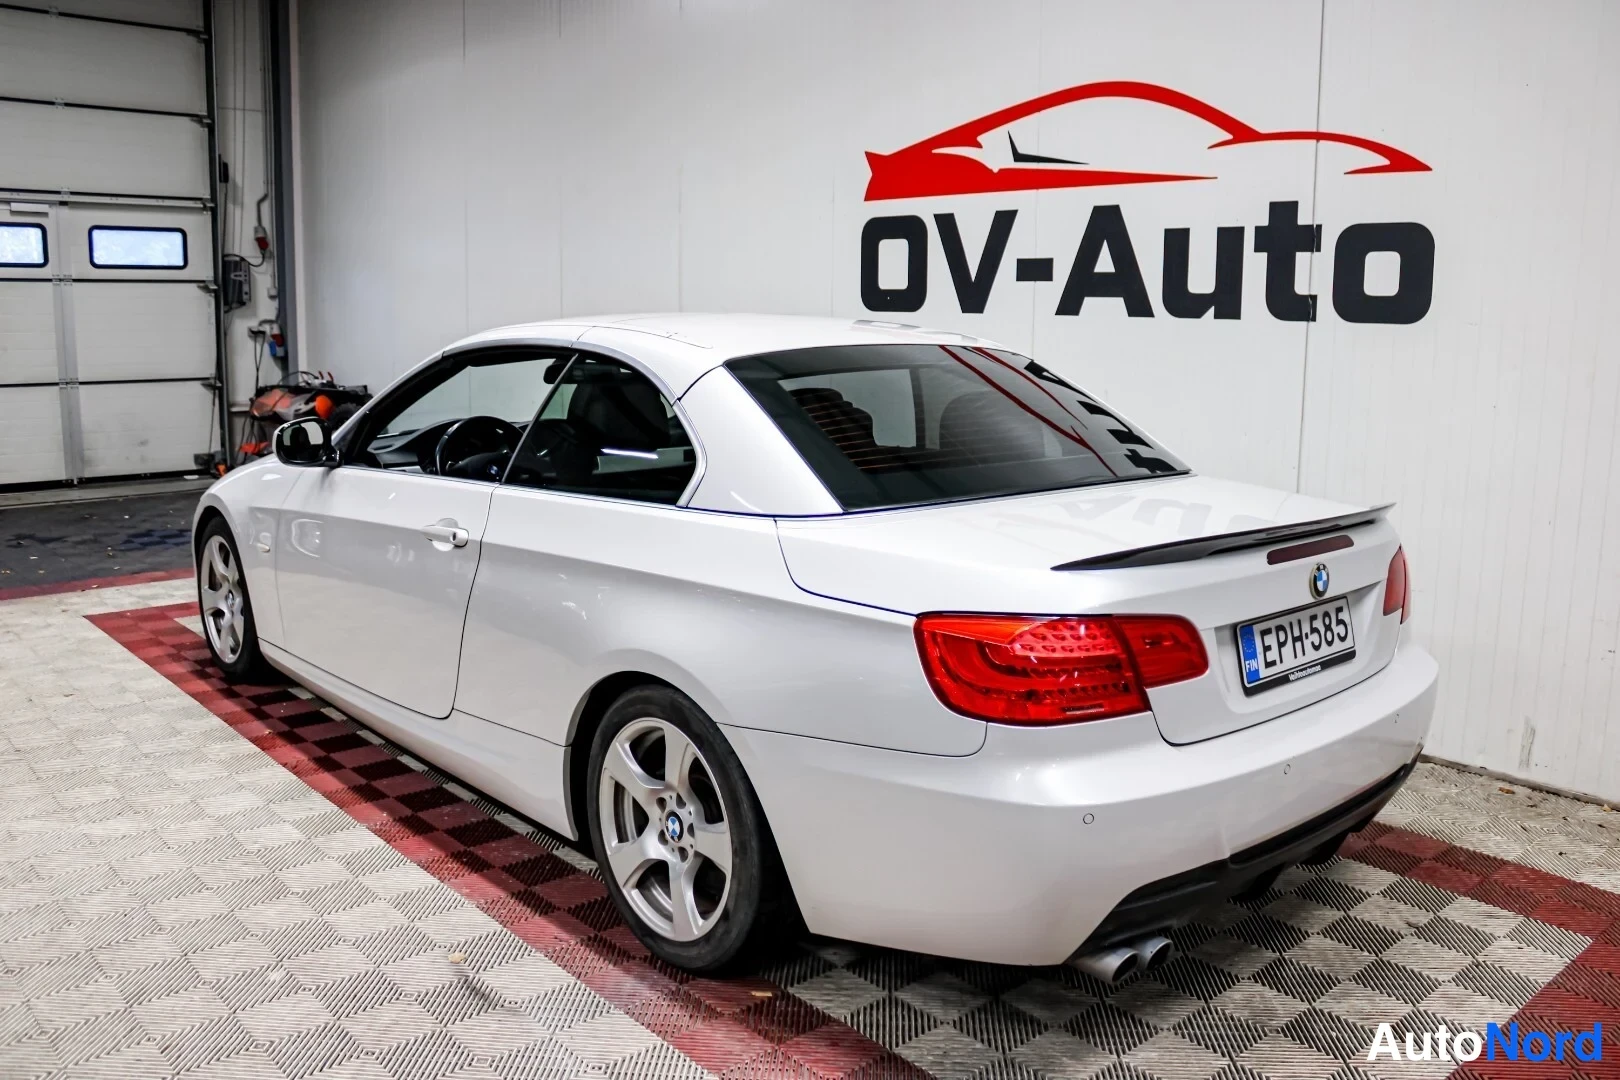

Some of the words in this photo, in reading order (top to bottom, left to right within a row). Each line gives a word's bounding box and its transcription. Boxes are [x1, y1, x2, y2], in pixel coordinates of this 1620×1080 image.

[860, 200, 1436, 324] OV-Auto
[1245, 658, 1260, 673] FIN
[1260, 606, 1349, 669] EPH-585
